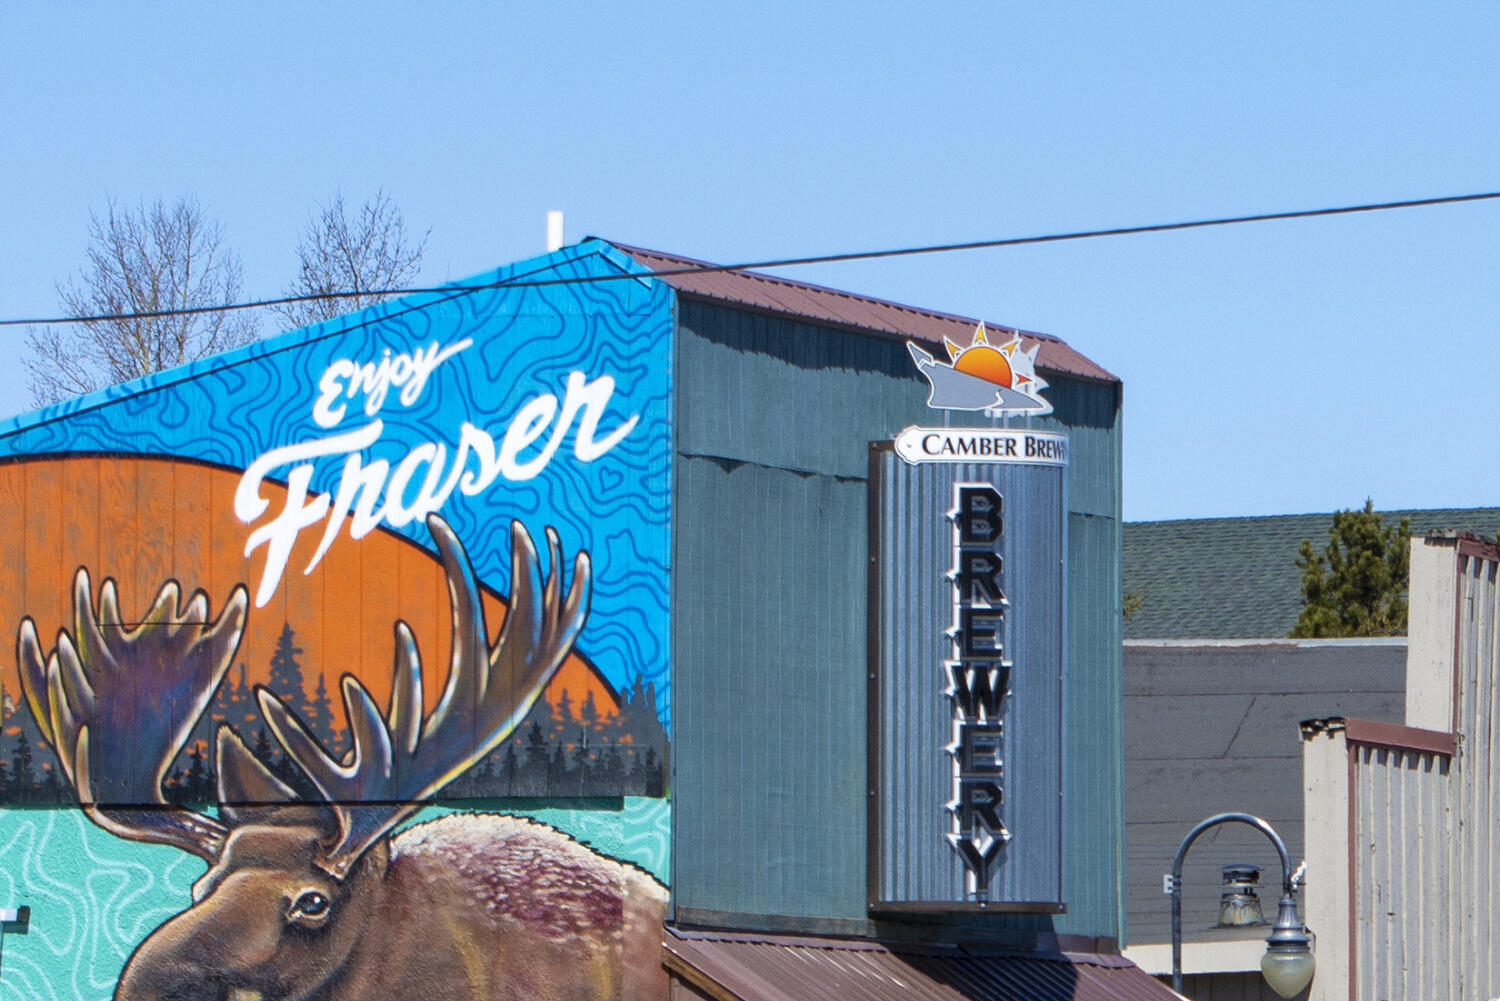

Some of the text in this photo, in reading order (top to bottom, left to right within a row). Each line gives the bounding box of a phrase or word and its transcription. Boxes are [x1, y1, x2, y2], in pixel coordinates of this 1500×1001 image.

[312, 337, 473, 428] Enjoy
[922, 434, 1065, 460] CAMBER BREW
[234, 370, 640, 608] Fraser
[945, 482, 1012, 905] BREWERY
